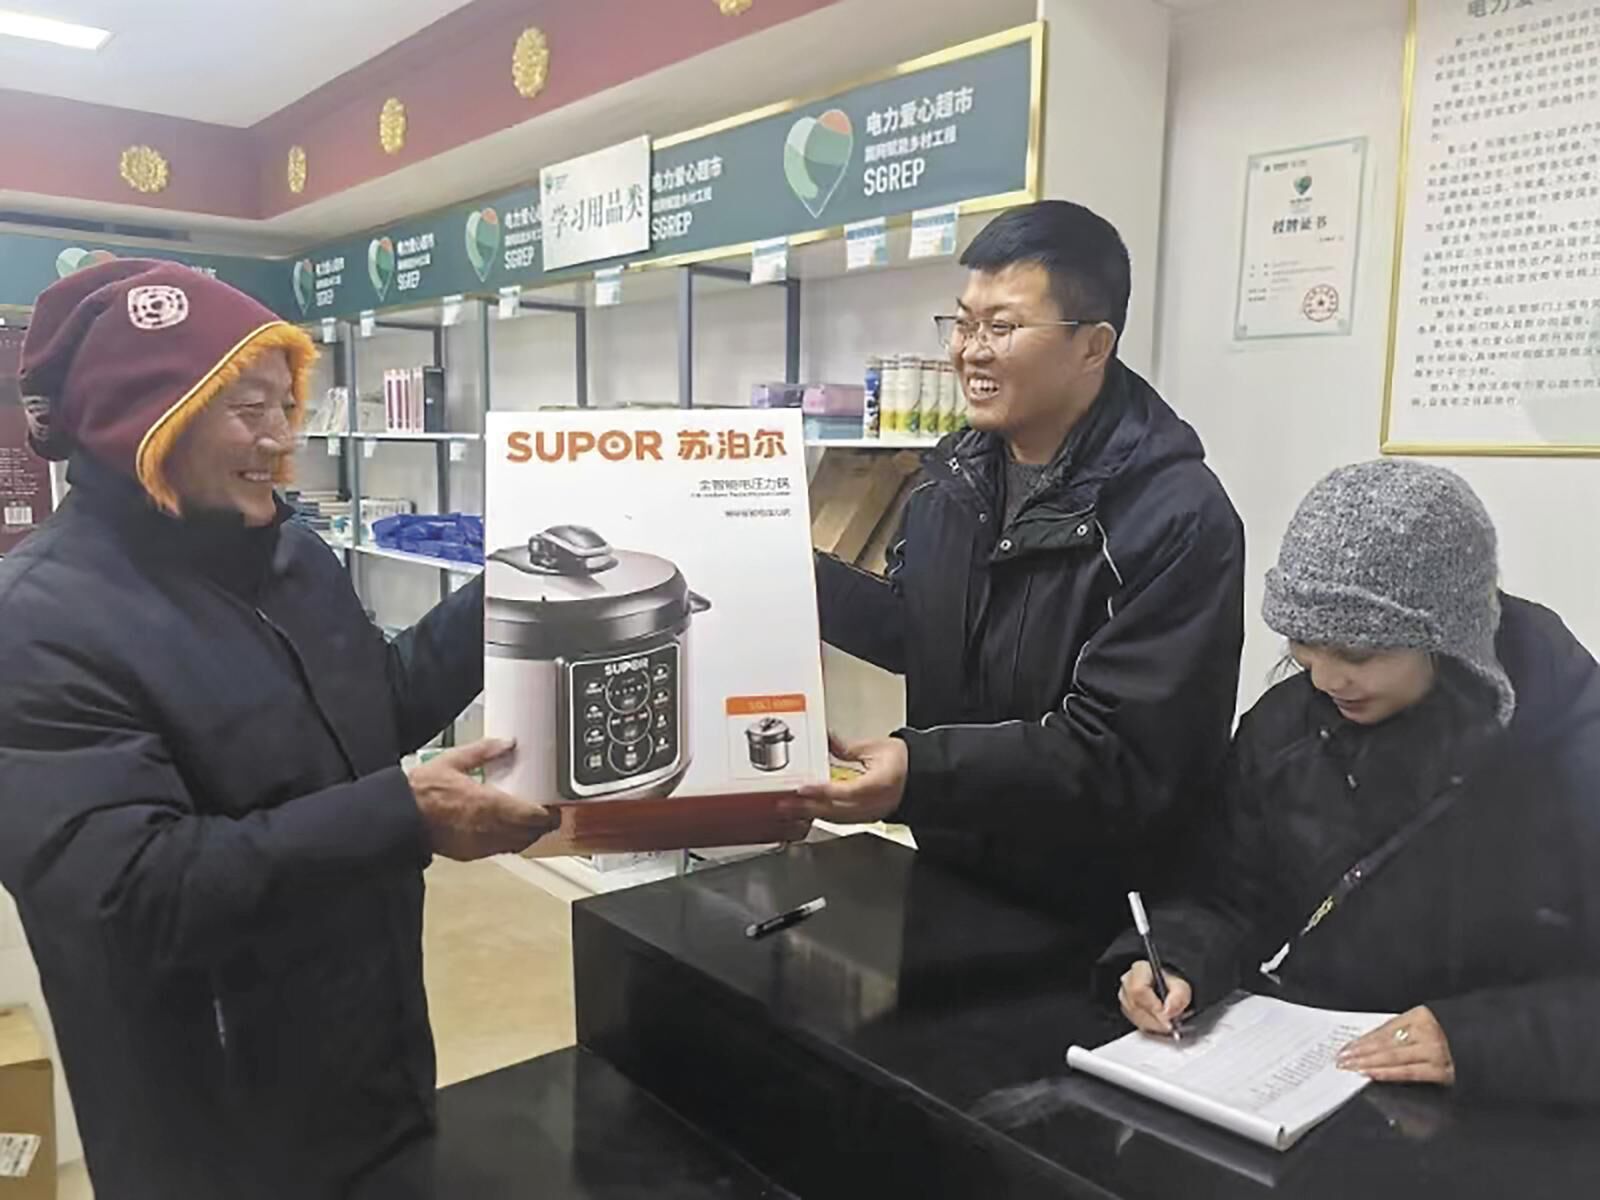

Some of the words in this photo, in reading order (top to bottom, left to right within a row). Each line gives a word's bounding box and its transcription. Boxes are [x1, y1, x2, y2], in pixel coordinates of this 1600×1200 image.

[864, 158, 926, 196] SGREP
[551, 183, 645, 239] 学习用品类
[652, 211, 693, 241] SGREP
[504, 245, 535, 270] SGREP
[506, 430, 663, 463] SUPOR
[676, 428, 788, 461] 苏泊尔
[604, 658, 648, 676] SUPOR
